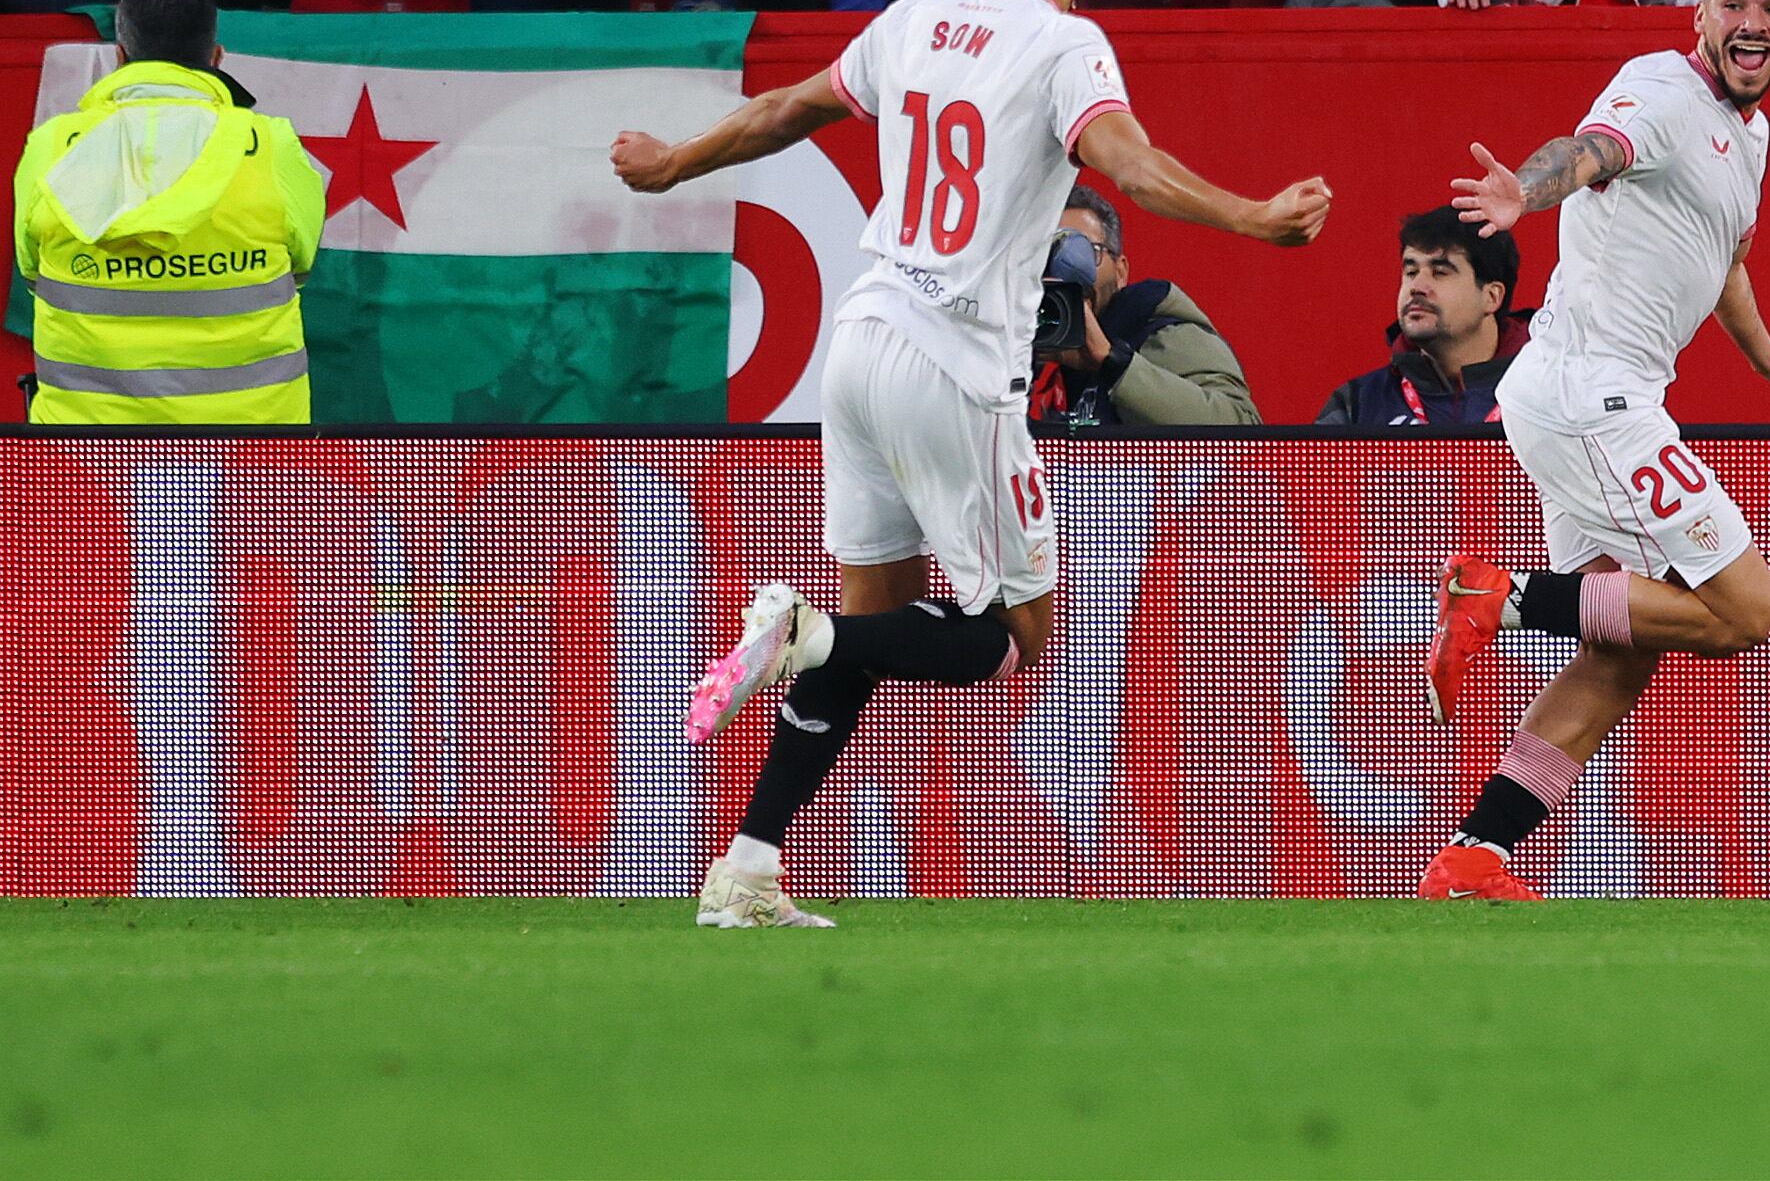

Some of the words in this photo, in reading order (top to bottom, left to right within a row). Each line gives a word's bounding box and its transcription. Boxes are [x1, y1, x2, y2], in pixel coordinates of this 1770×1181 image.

[929, 20, 995, 60] SOW
[900, 91, 986, 256] 18
[105, 249, 268, 281] PROSEGUR
[1632, 444, 1708, 520] 20
